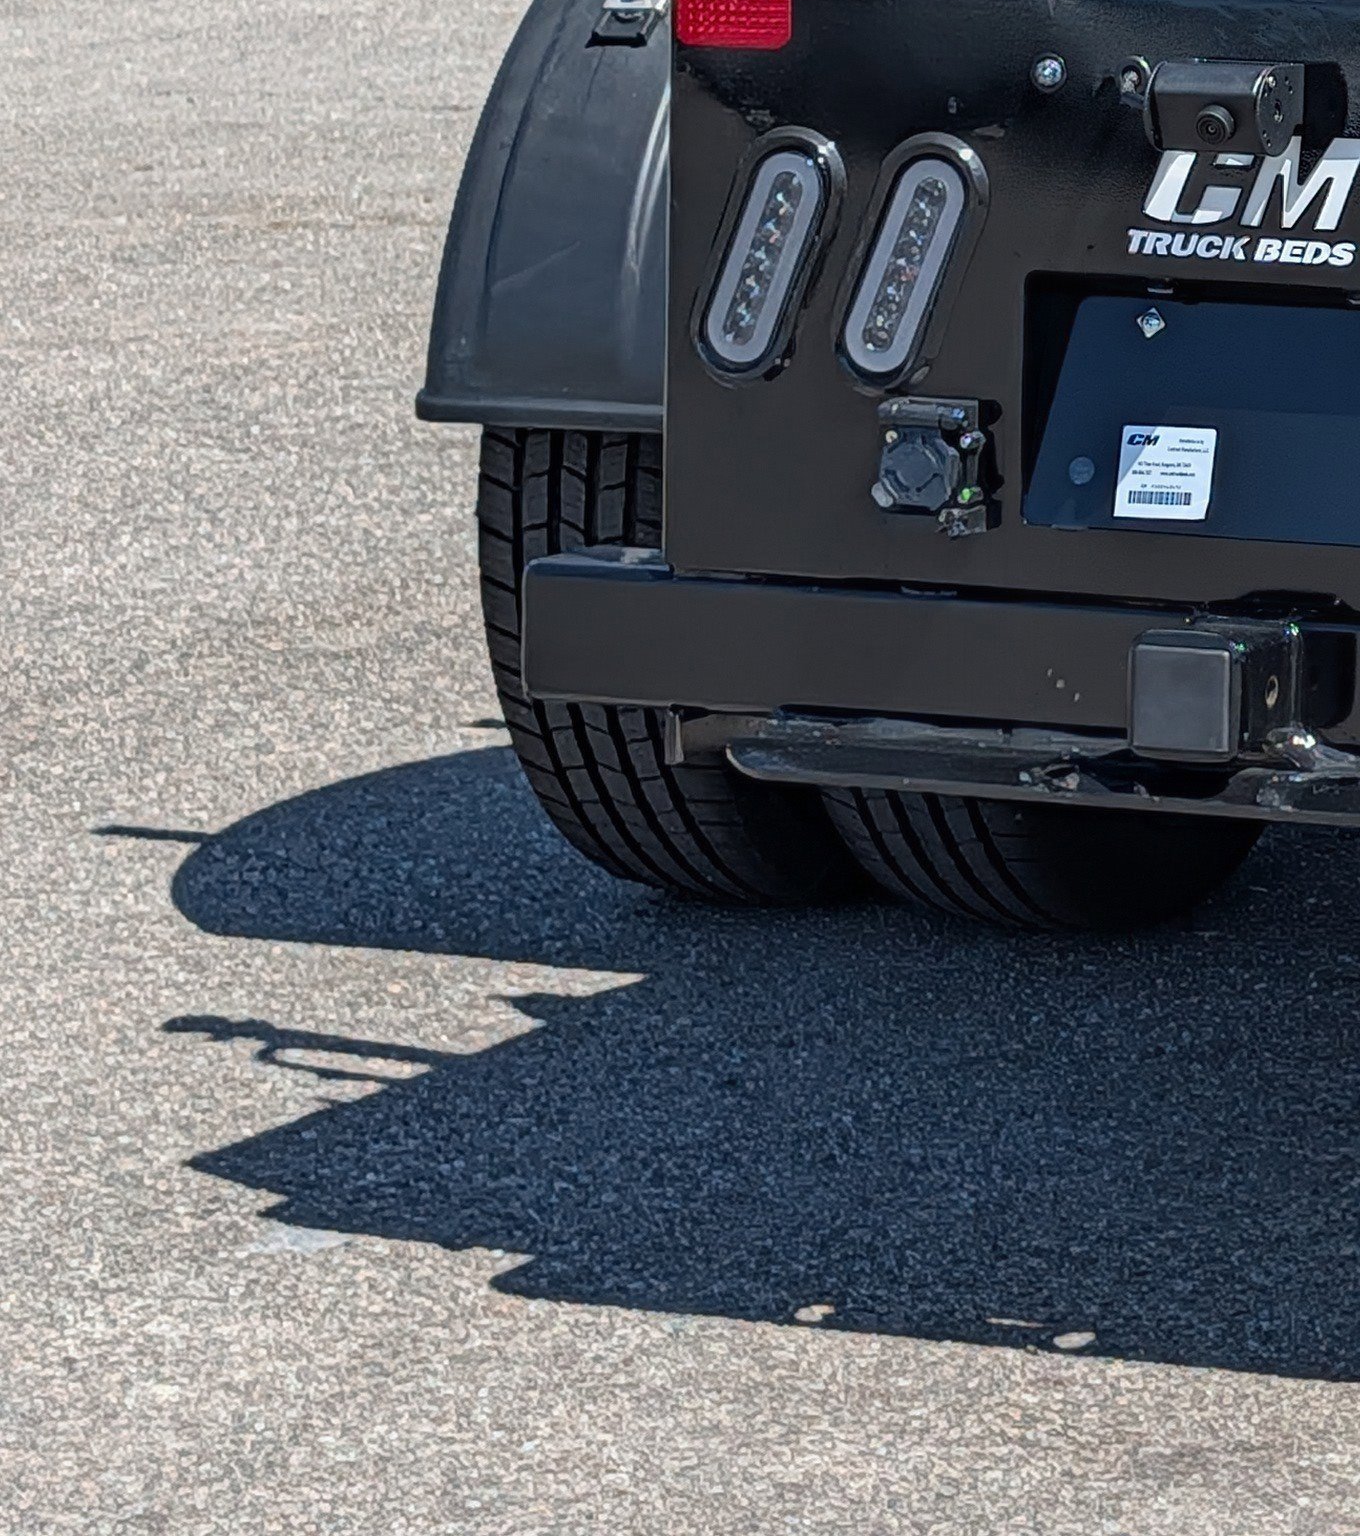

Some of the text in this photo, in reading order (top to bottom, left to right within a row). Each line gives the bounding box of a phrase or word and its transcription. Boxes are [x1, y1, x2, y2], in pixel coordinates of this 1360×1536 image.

[1127, 228, 1357, 267] TRUCK BEDS
[1127, 433, 1160, 447] CM
